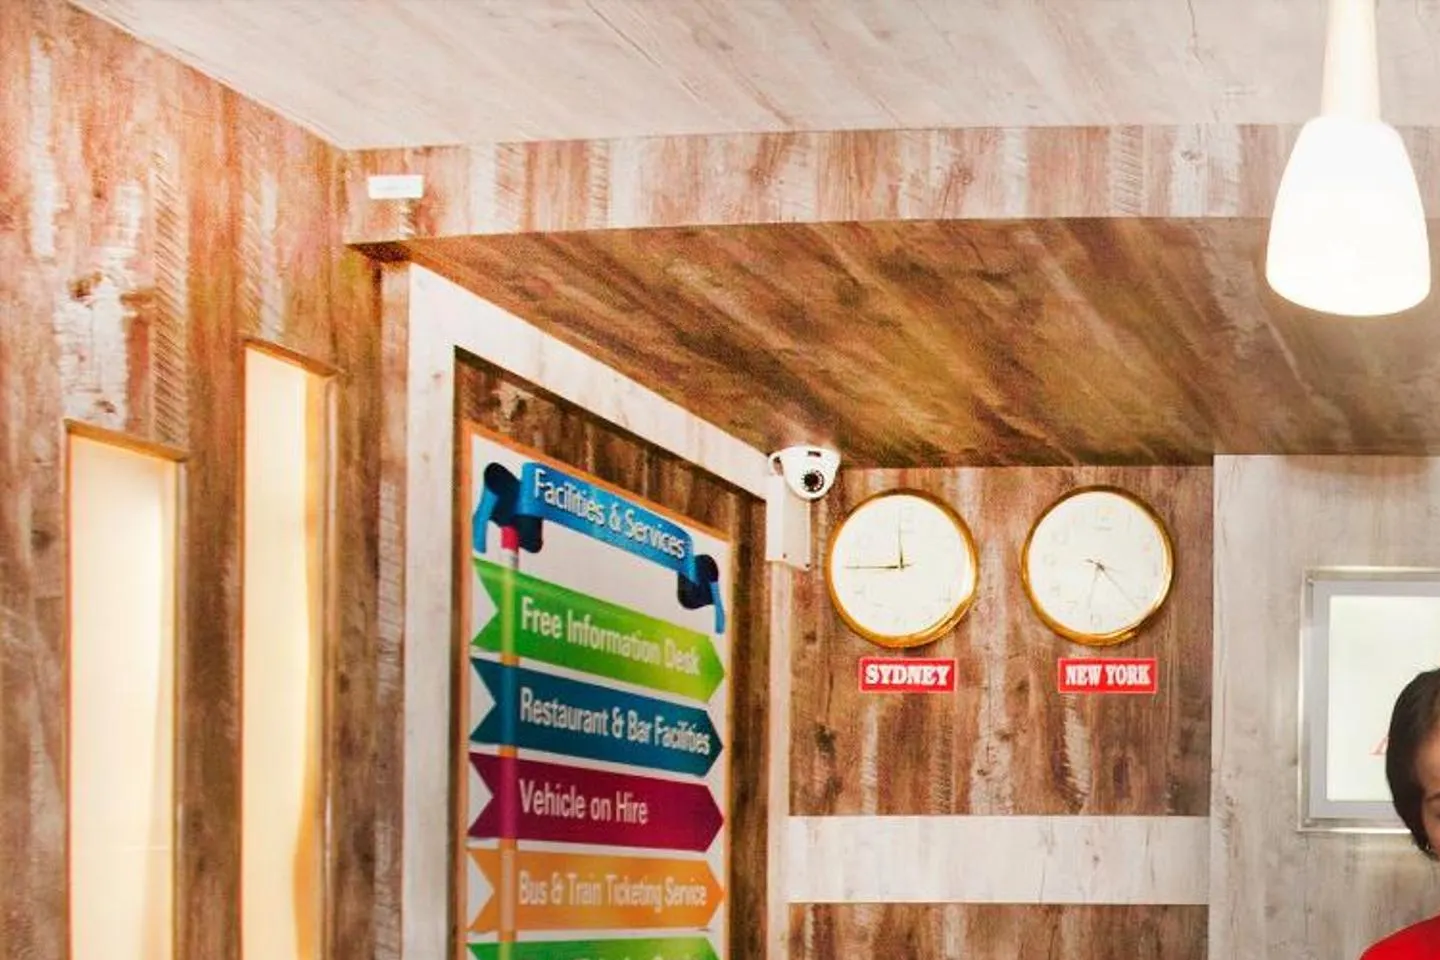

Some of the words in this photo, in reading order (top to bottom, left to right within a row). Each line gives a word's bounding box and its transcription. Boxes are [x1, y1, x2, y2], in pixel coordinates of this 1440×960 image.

[534, 467, 605, 521] Facilities
[608, 502, 622, 533] &
[625, 509, 687, 559] Services
[521, 596, 564, 638] Free
[567, 611, 661, 666] Information
[664, 639, 702, 676] Desk
[864, 664, 950, 687] SYDNEY
[1064, 664, 1100, 685] NEW
[1103, 664, 1152, 687] YORK
[520, 687, 609, 737] Restaurant
[611, 705, 625, 736] &
[627, 710, 651, 743] Bar
[654, 715, 711, 756] Facilities
[519, 778, 586, 820] Vehicle
[590, 798, 612, 821] on
[616, 790, 649, 825] Hire
[519, 871, 547, 905] Bus
[550, 871, 565, 905] &
[567, 872, 601, 906] Train
[605, 874, 663, 913] Ticketing
[665, 877, 707, 907] Service
